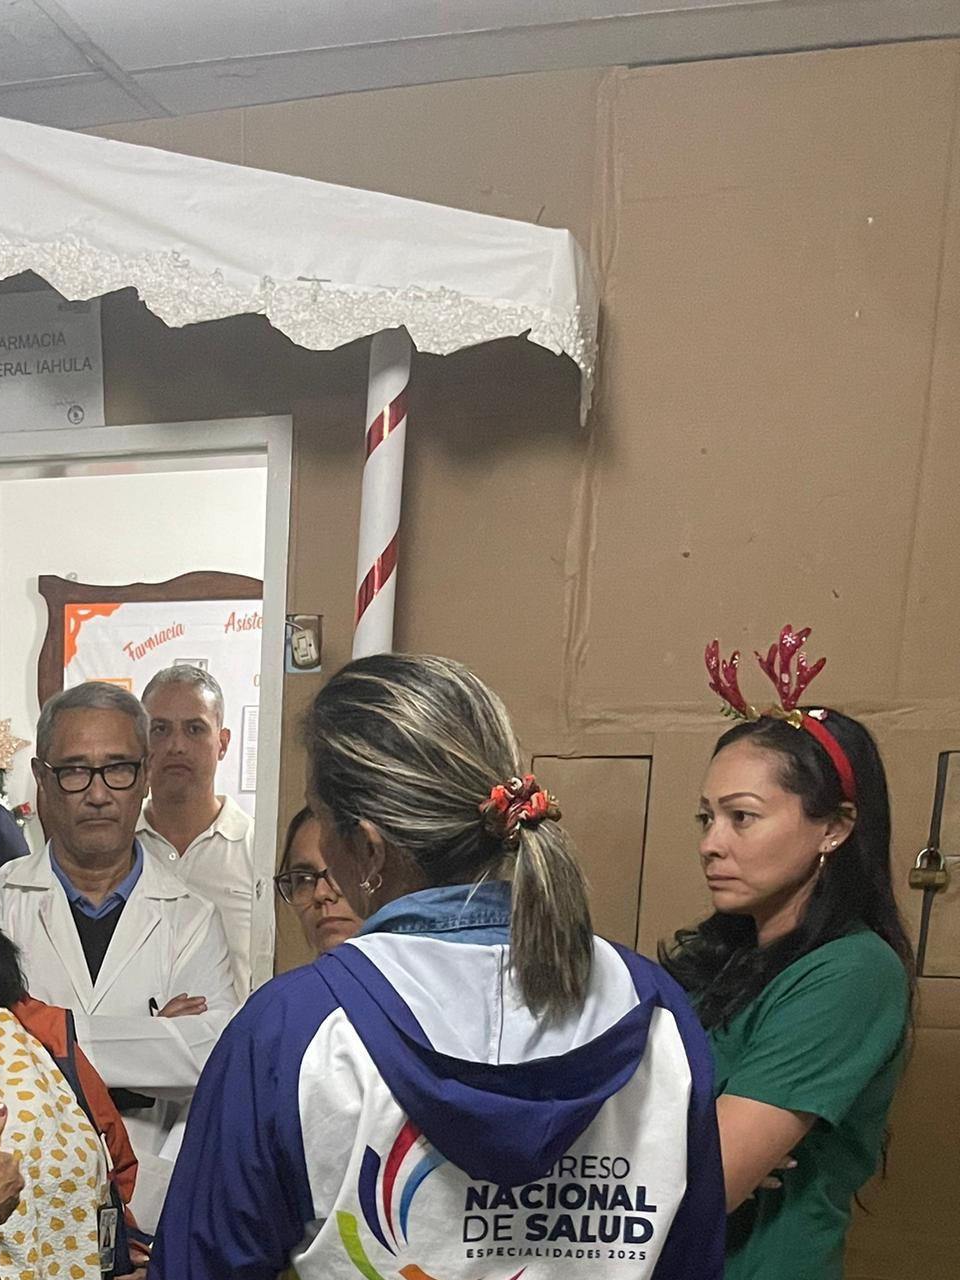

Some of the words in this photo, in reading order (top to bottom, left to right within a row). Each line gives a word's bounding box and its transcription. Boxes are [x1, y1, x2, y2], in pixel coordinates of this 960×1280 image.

[36, 356, 93, 376] IAHULA
[123, 621, 185, 662] Farmacia
[465, 1182, 657, 1213] NACIONAL
[463, 1214, 514, 1242] DE
[525, 1213, 654, 1244] SALUD
[466, 1247, 601, 1259] ESPECIALIDADES
[608, 1250, 646, 1260] 2025
